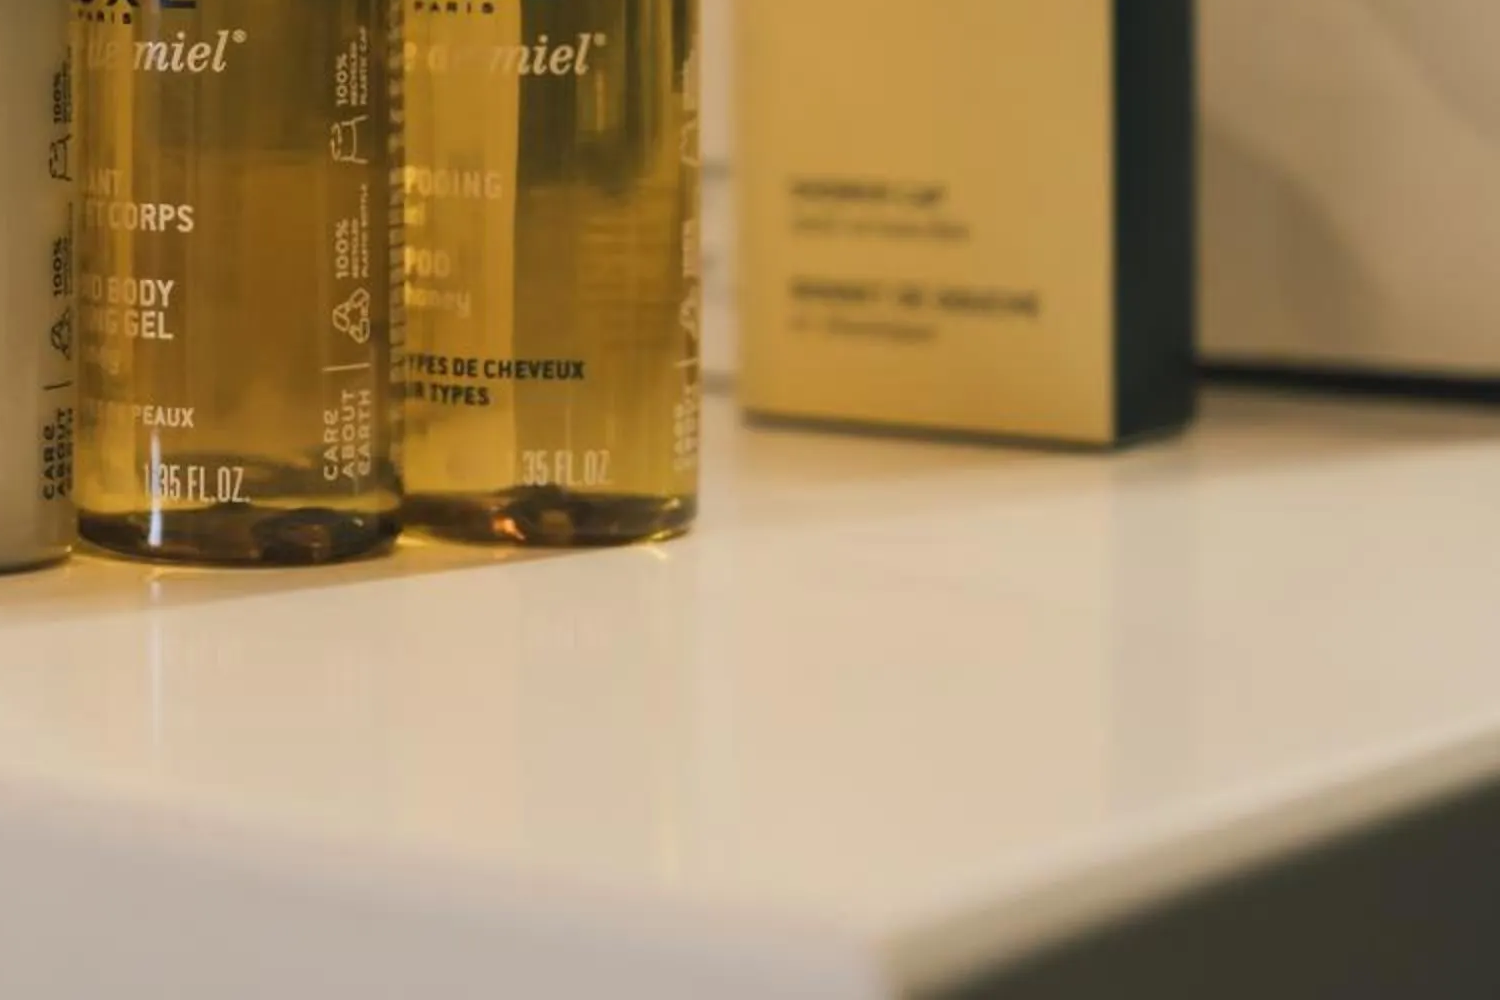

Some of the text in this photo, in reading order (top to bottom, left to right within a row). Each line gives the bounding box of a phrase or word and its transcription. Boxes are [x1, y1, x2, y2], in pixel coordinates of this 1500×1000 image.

[77, 11, 132, 25] PARIS
[414, 1, 495, 15] PARIS
[335, 53, 349, 107] 100%
[107, 203, 195, 233] CORPS
[335, 217, 350, 281] 100%
[52, 236, 62, 297] 100%
[107, 279, 175, 309] BODY
[123, 311, 175, 340] GEL
[452, 356, 478, 379] DE
[483, 358, 586, 383] CHEVEUX
[429, 382, 491, 407] TYPES
[341, 388, 356, 480] ABOUT
